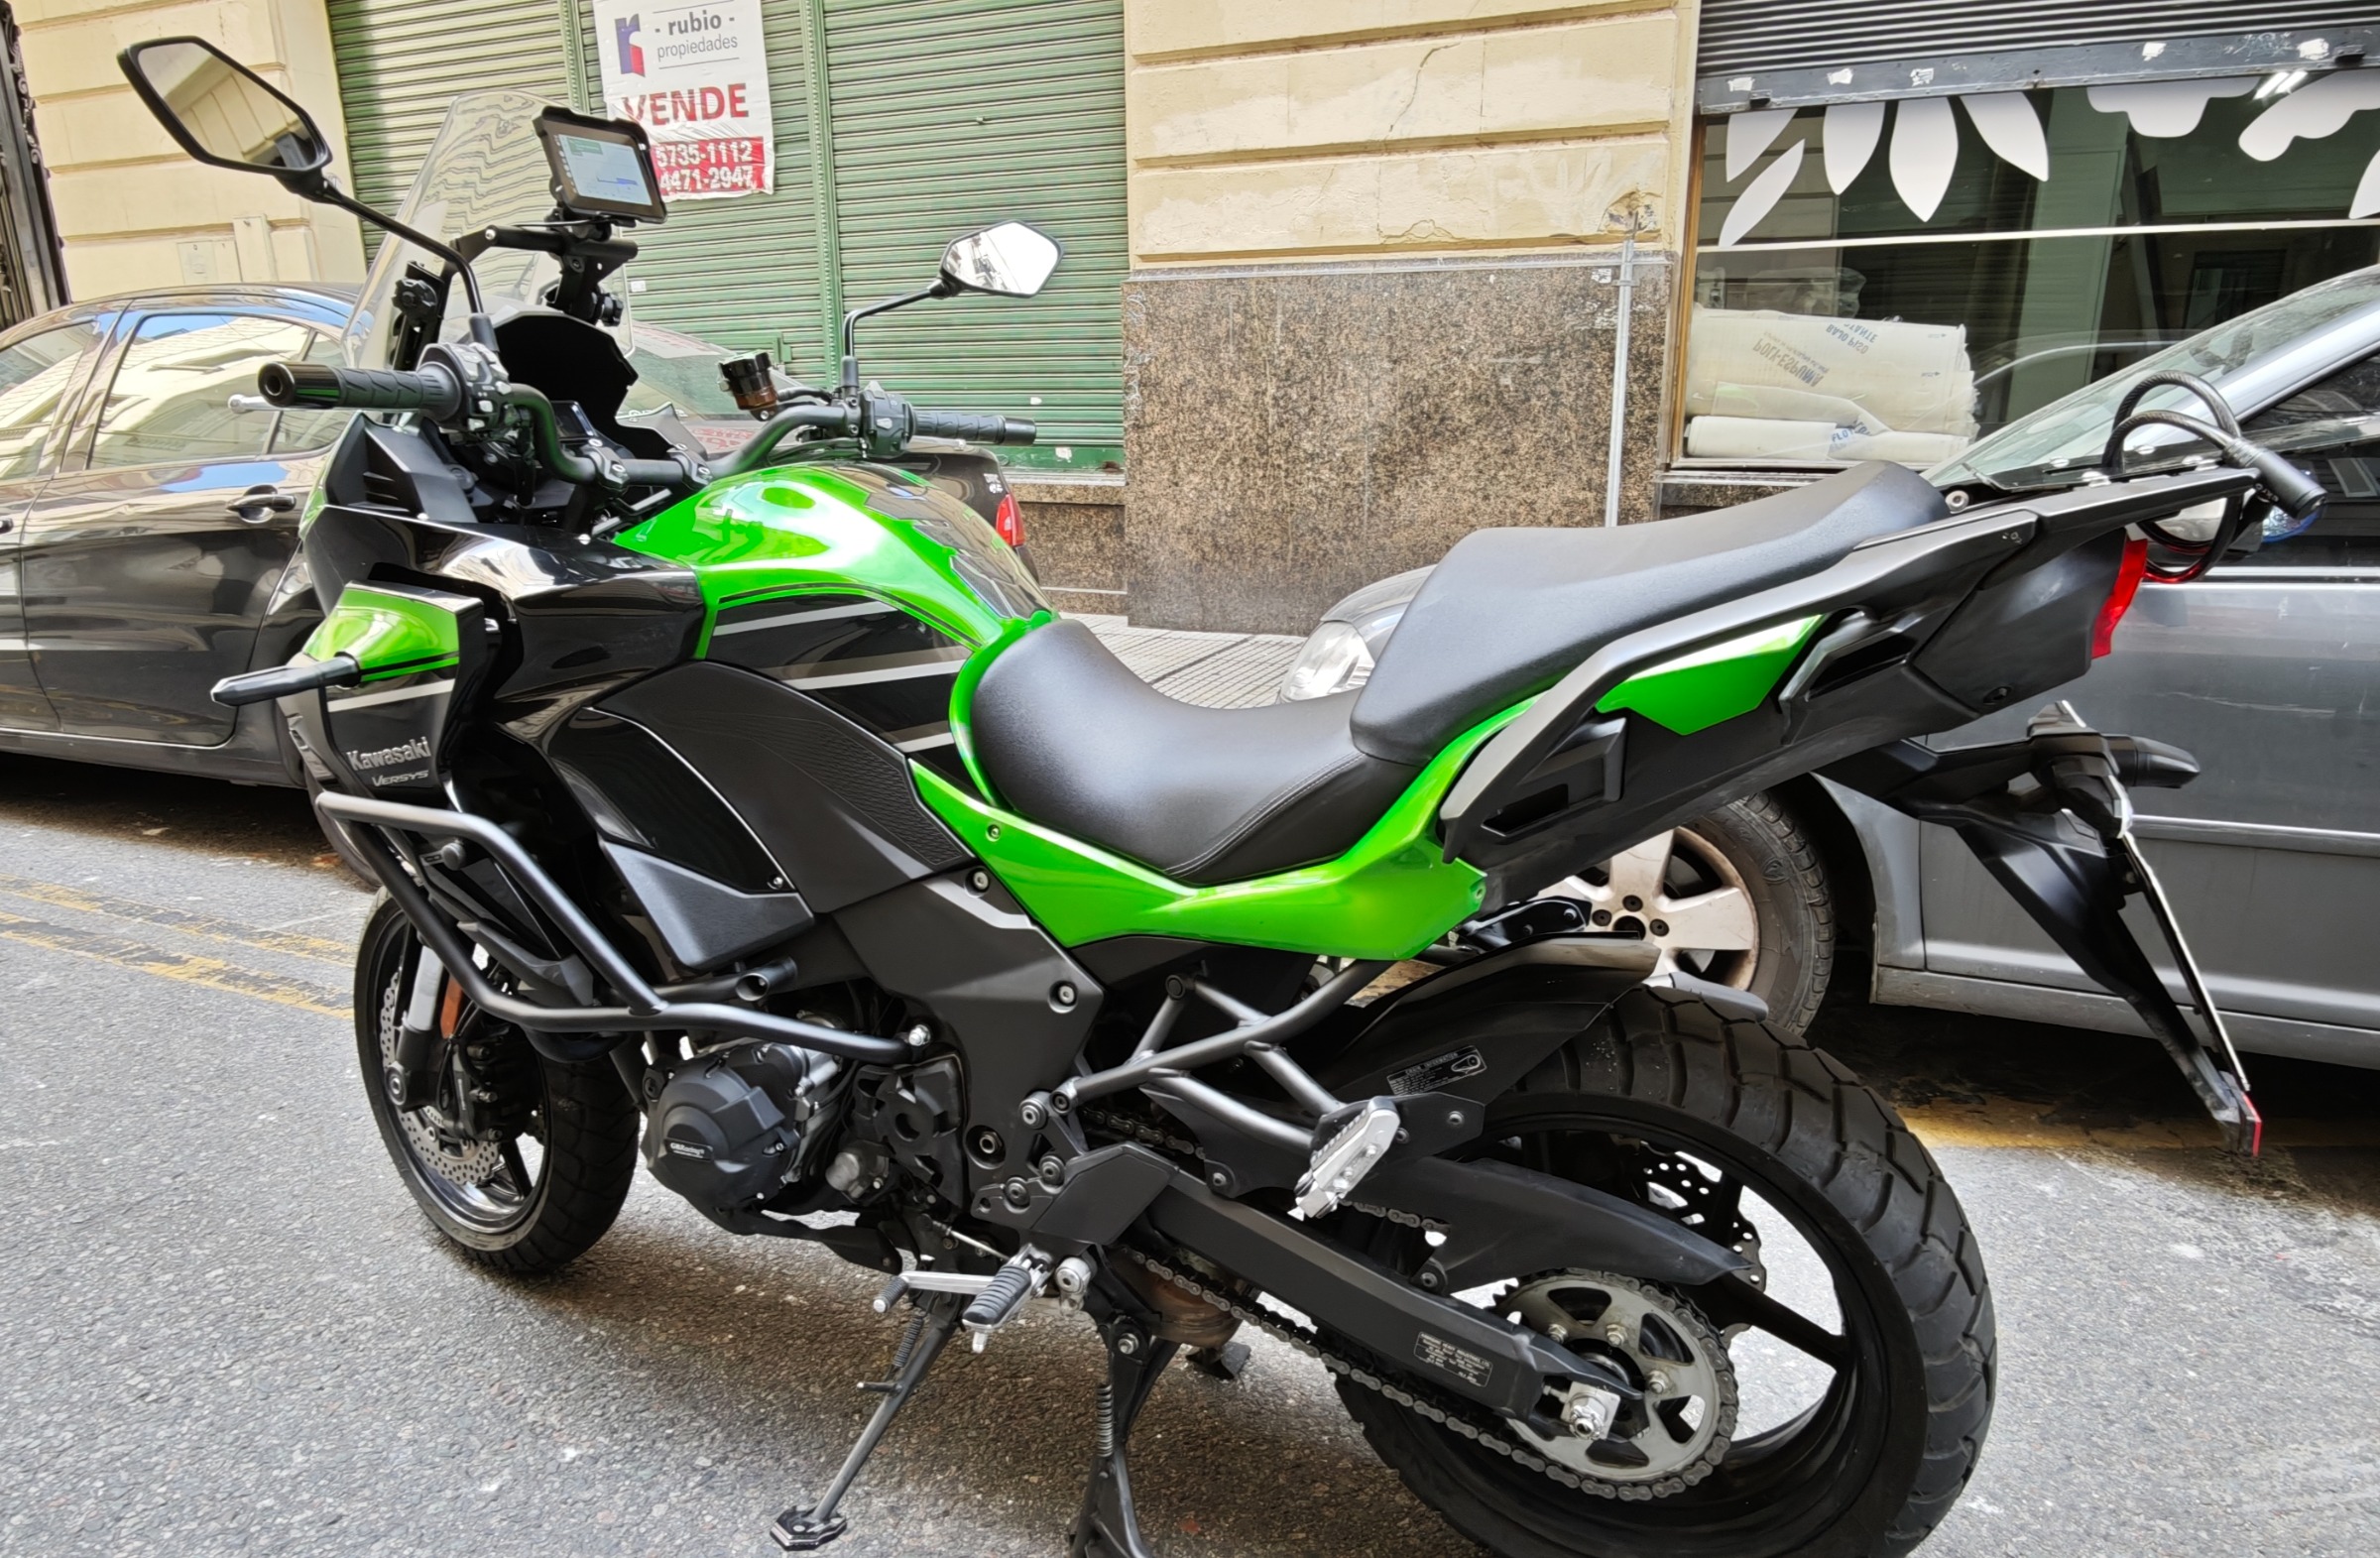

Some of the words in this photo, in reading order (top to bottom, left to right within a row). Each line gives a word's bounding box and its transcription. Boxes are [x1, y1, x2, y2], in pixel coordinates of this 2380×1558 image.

[667, 9, 722, 37] rubio
[656, 34, 738, 61] propiedades
[622, 82, 750, 126] VENDE
[655, 140, 754, 168] 5735-1112
[346, 736, 431, 771] Kawasaki
